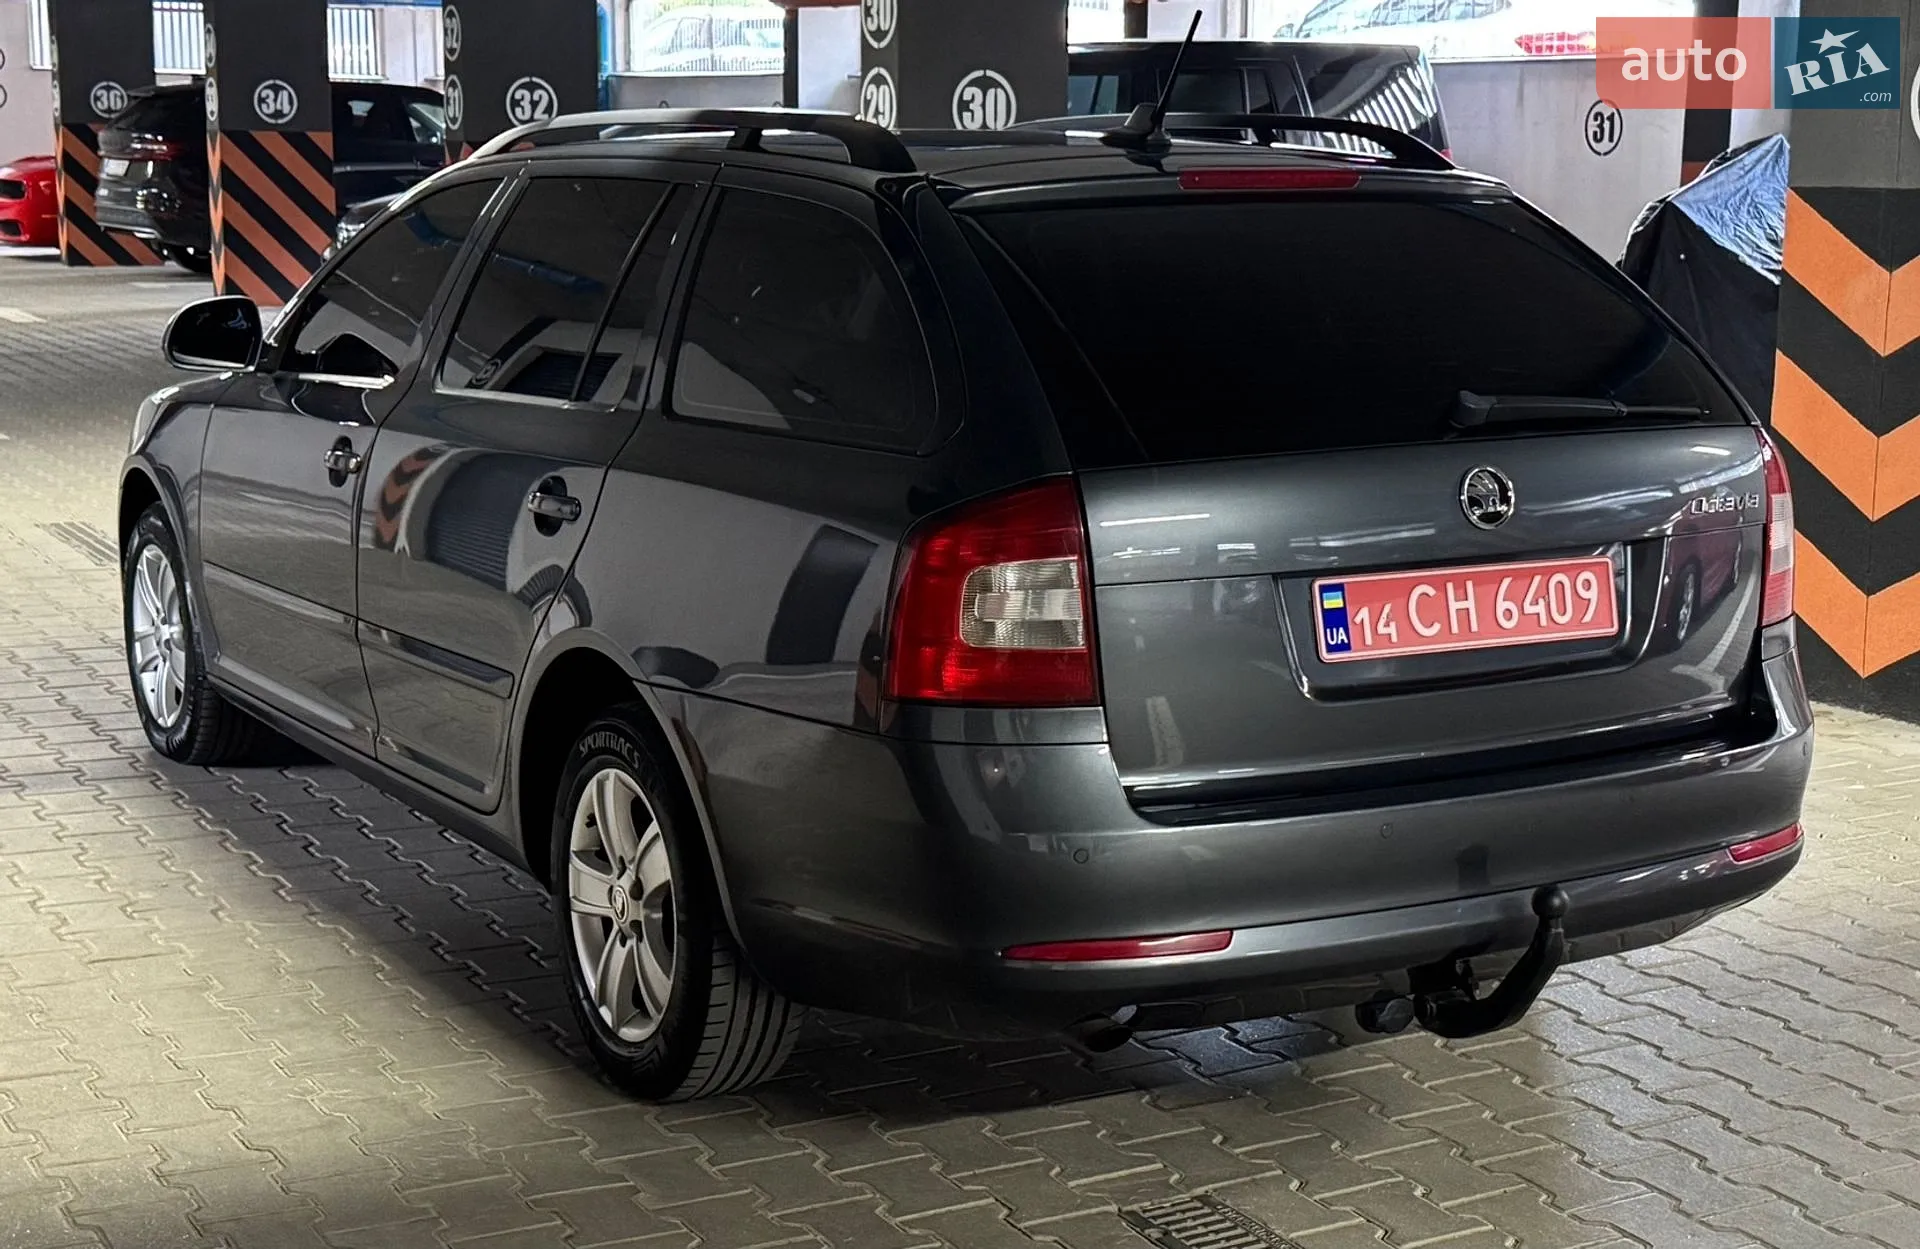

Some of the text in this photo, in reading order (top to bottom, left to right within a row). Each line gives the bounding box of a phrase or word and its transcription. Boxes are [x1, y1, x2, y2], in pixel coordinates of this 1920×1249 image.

[866, 0, 891, 31] 30
[260, 88, 292, 115] 34
[447, 86, 459, 119] 31
[514, 88, 550, 120] 32
[866, 83, 890, 128] 29
[962, 86, 1007, 130] 30
[1592, 111, 1615, 144] 31
[1691, 491, 1760, 514] Octavia
[1353, 570, 1599, 646] 14 CH 6409
[1326, 628, 1348, 645] UA
